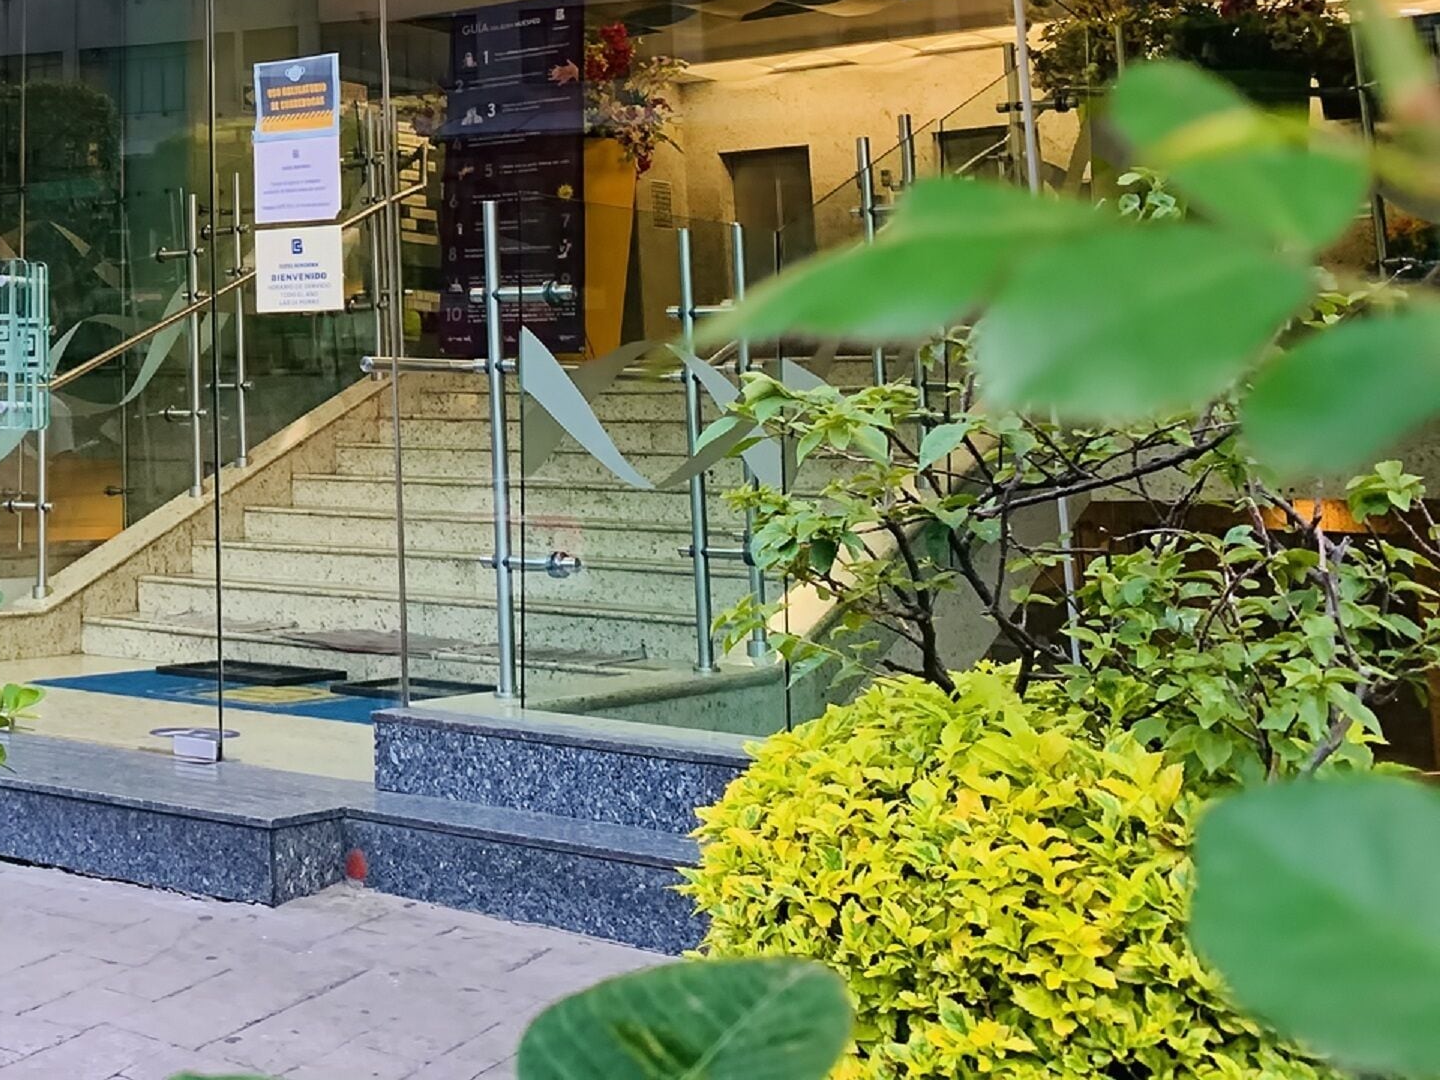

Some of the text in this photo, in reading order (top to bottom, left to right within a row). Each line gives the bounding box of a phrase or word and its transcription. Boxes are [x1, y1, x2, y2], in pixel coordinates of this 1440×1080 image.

[484, 50, 489, 65] 1
[455, 79, 464, 93] 2
[487, 103, 496, 118] 3
[485, 163, 493, 178] 5
[449, 194, 458, 208] 6
[561, 213, 571, 228] 7
[448, 247, 457, 261] 8
[271, 272, 327, 281] BIENVENIDO
[445, 307, 462, 322] 10
